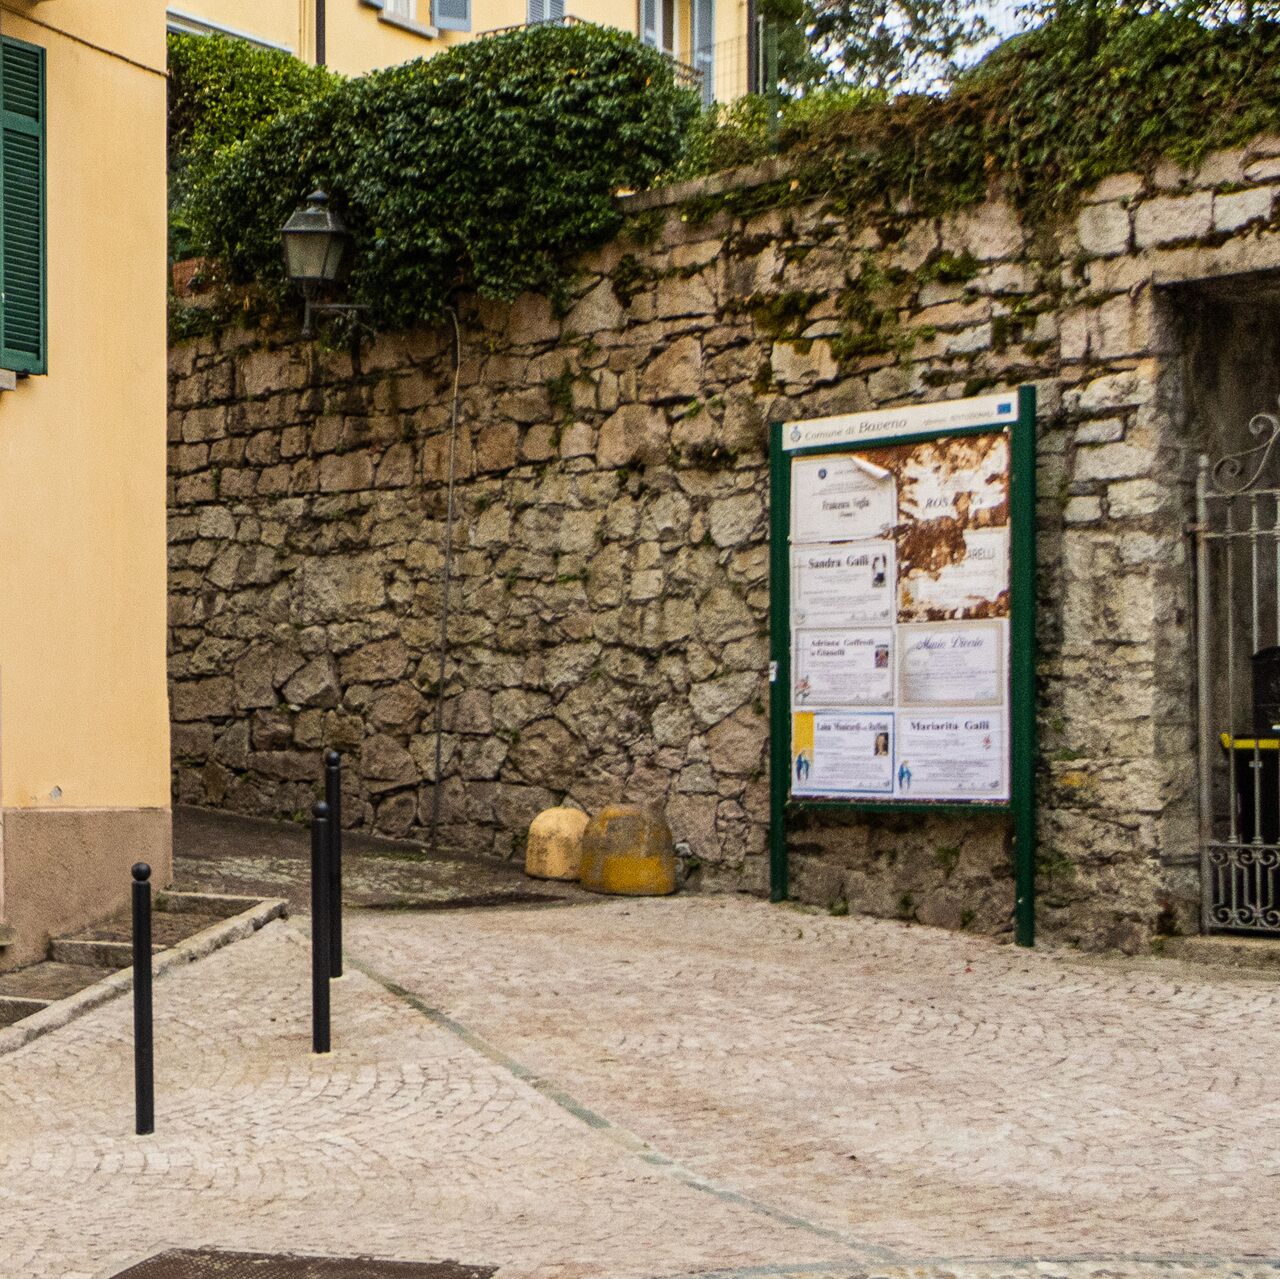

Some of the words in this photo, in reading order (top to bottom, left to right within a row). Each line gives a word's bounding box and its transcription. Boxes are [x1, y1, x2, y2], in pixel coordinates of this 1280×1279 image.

[804, 428, 843, 441] Comune
[845, 426, 855, 437] di
[858, 418, 908, 434] Baveno
[967, 548, 996, 560] ARELLI
[808, 557, 842, 569] Sandra
[846, 554, 869, 567] Galli
[911, 721, 959, 731] Mariarita
[964, 720, 990, 730] Galli
